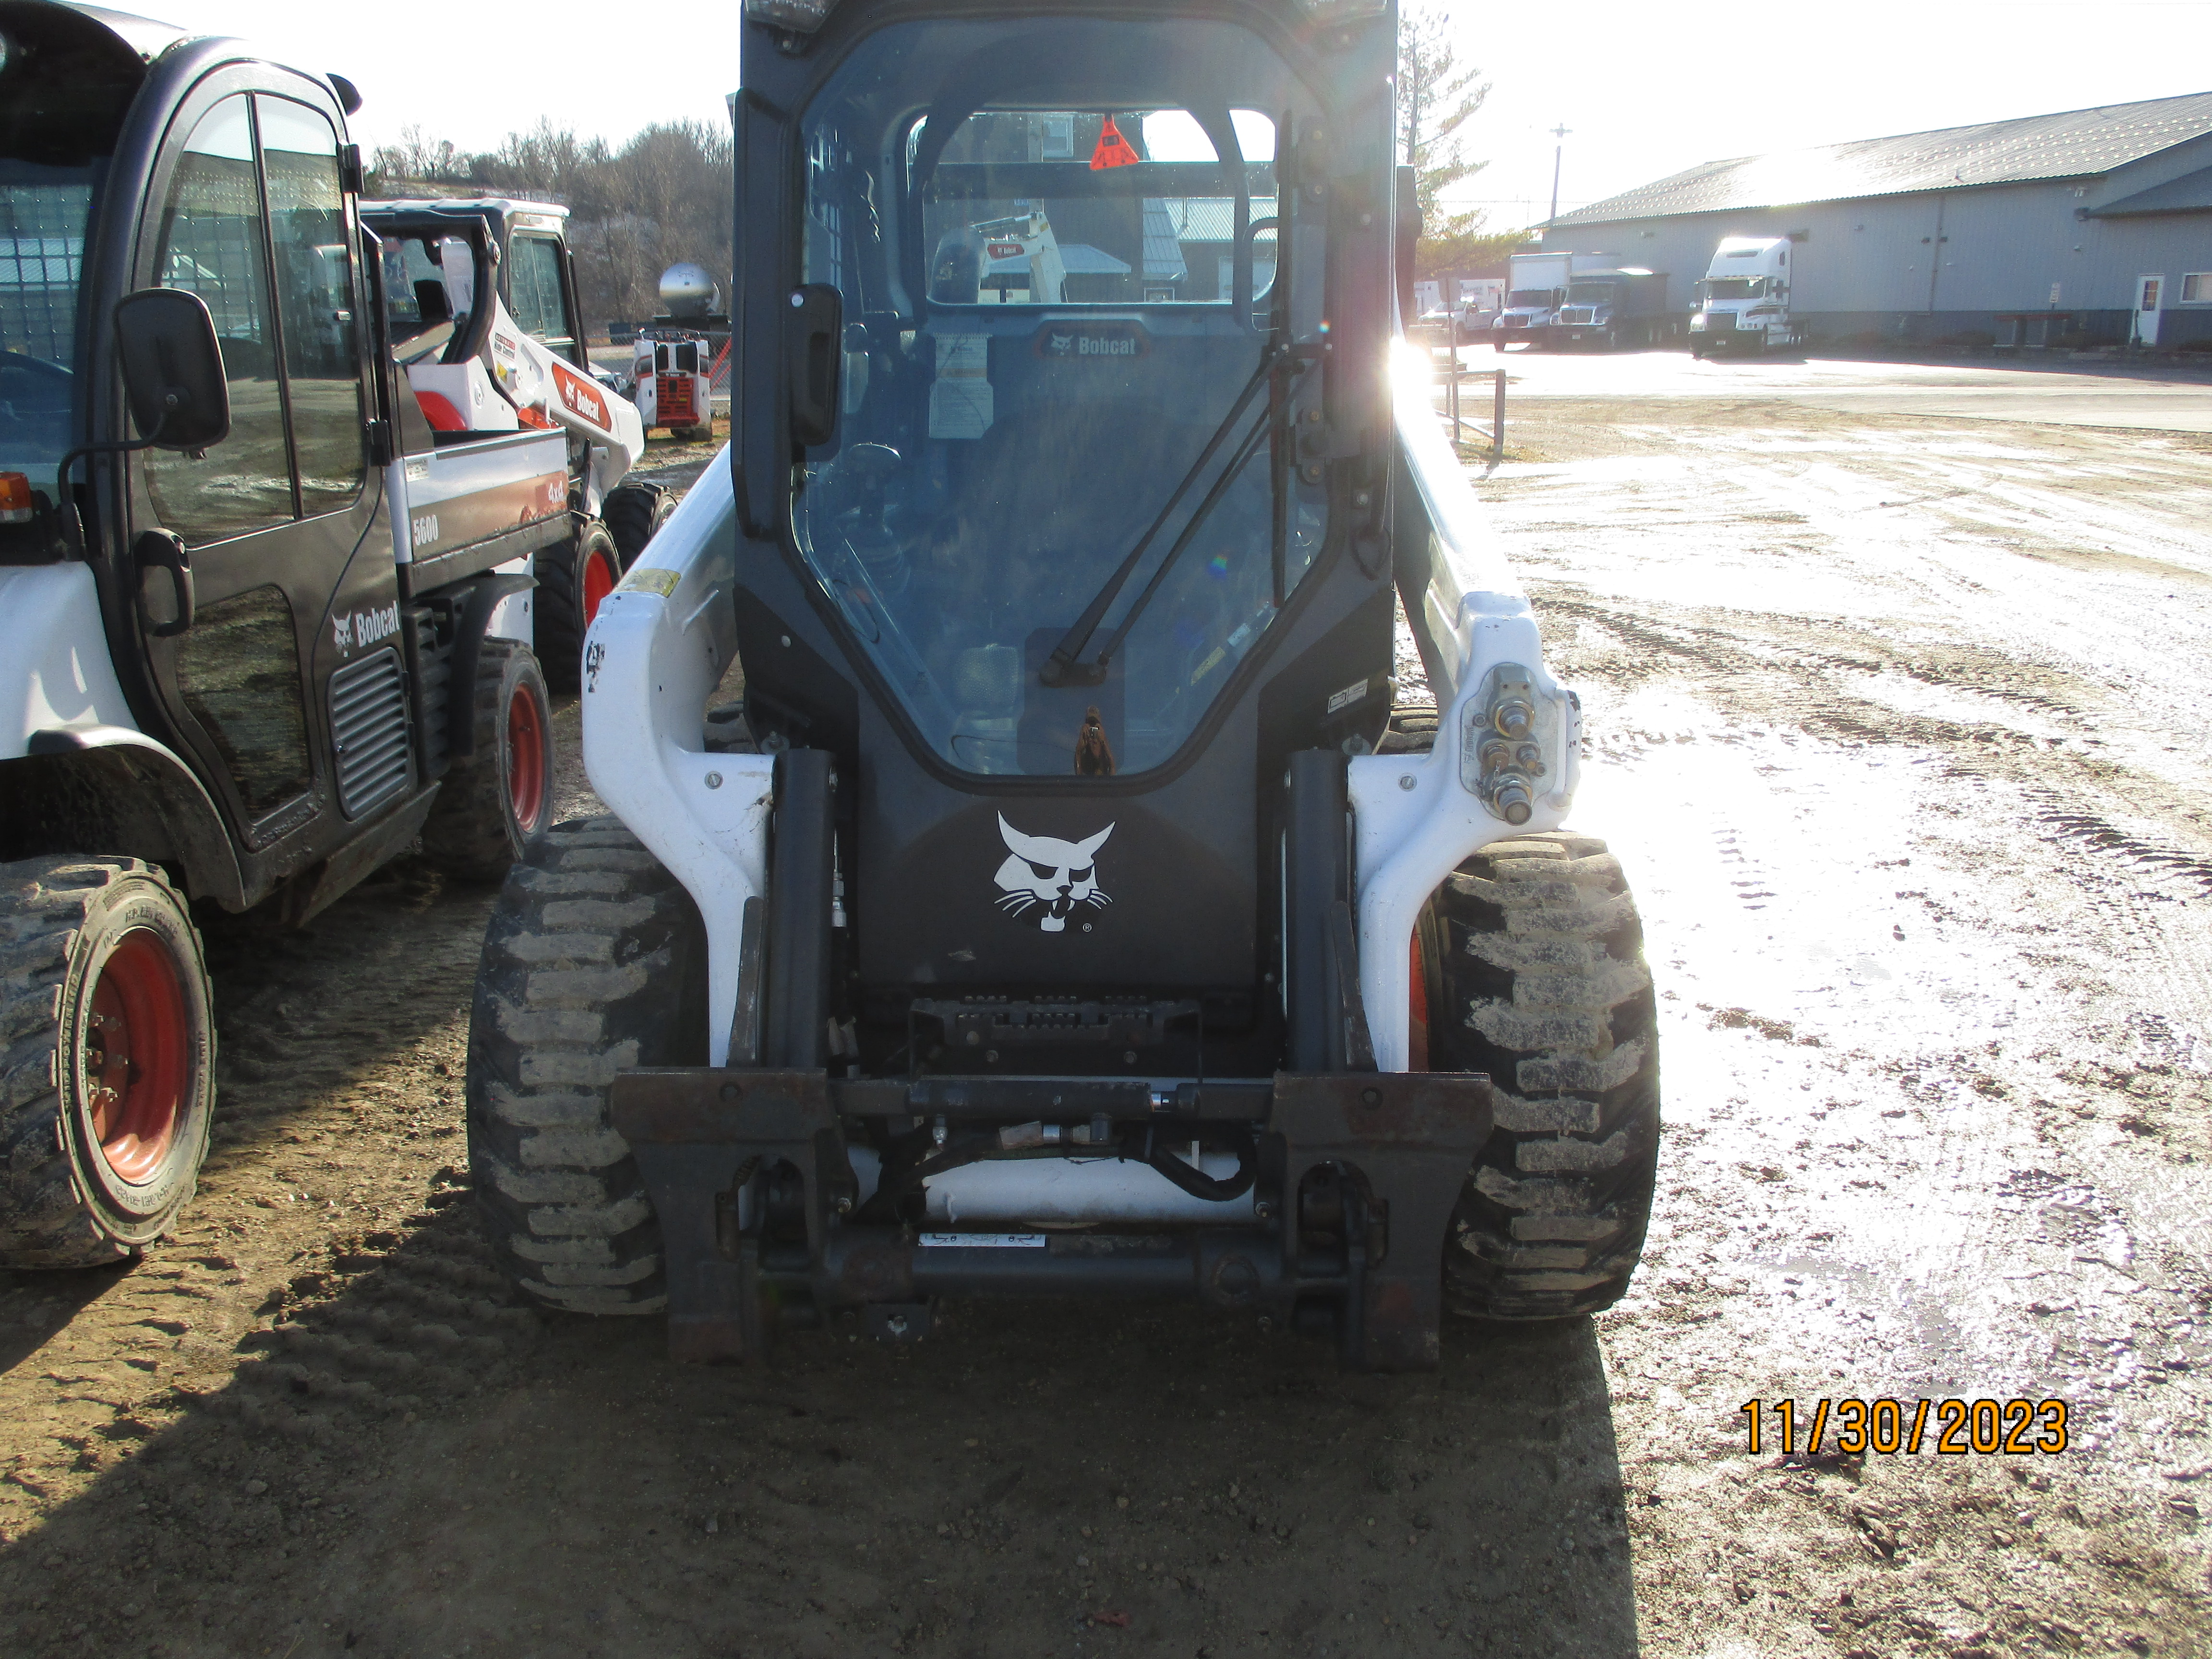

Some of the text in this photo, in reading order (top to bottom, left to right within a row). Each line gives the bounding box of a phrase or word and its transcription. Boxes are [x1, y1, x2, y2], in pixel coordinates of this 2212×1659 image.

[1079, 337, 1136, 355] Bobcat
[577, 389, 600, 422] Bobcat
[548, 480, 564, 504] 4x4
[413, 514, 439, 546] 5600
[355, 600, 400, 648] Bobcat
